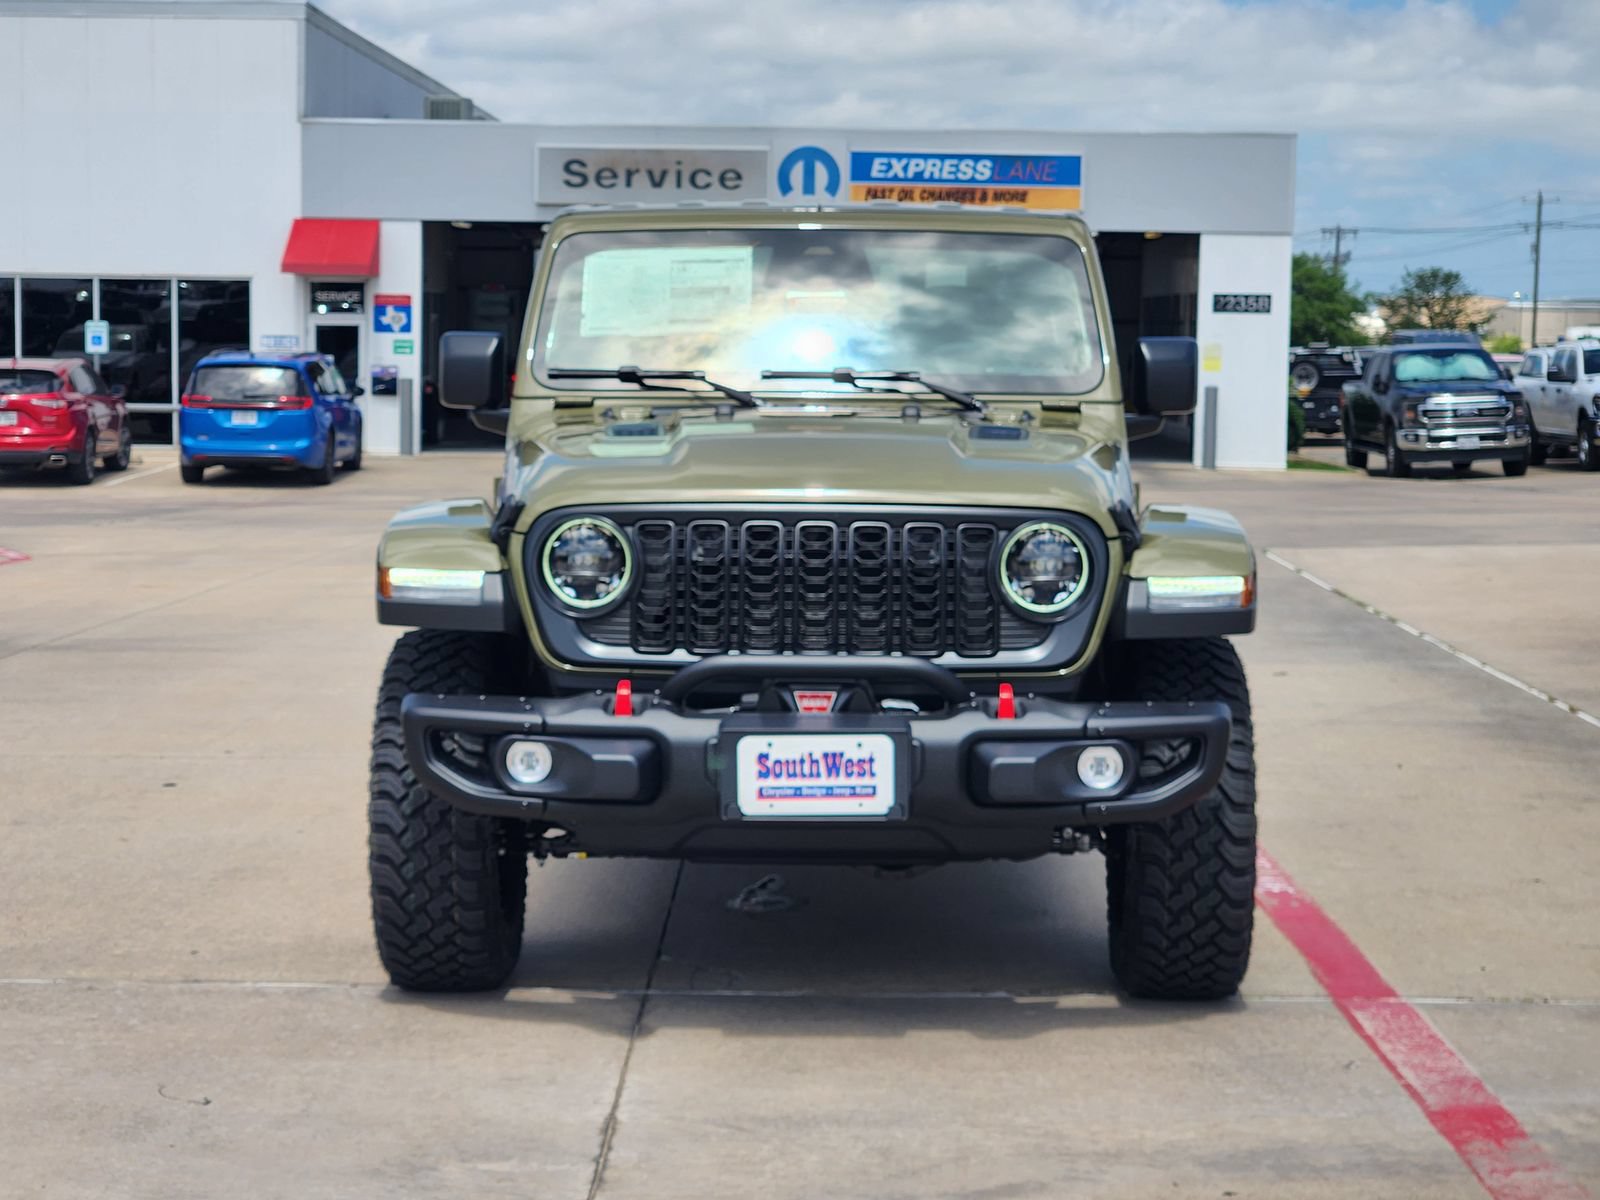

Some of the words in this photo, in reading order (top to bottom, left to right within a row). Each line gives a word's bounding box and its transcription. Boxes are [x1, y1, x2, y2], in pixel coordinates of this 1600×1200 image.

[562, 158, 743, 190] Service
[865, 187, 895, 201] FAST
[897, 188, 914, 202] OIL
[315, 290, 361, 302] SERVICE
[757, 752, 877, 780] SouthWest
